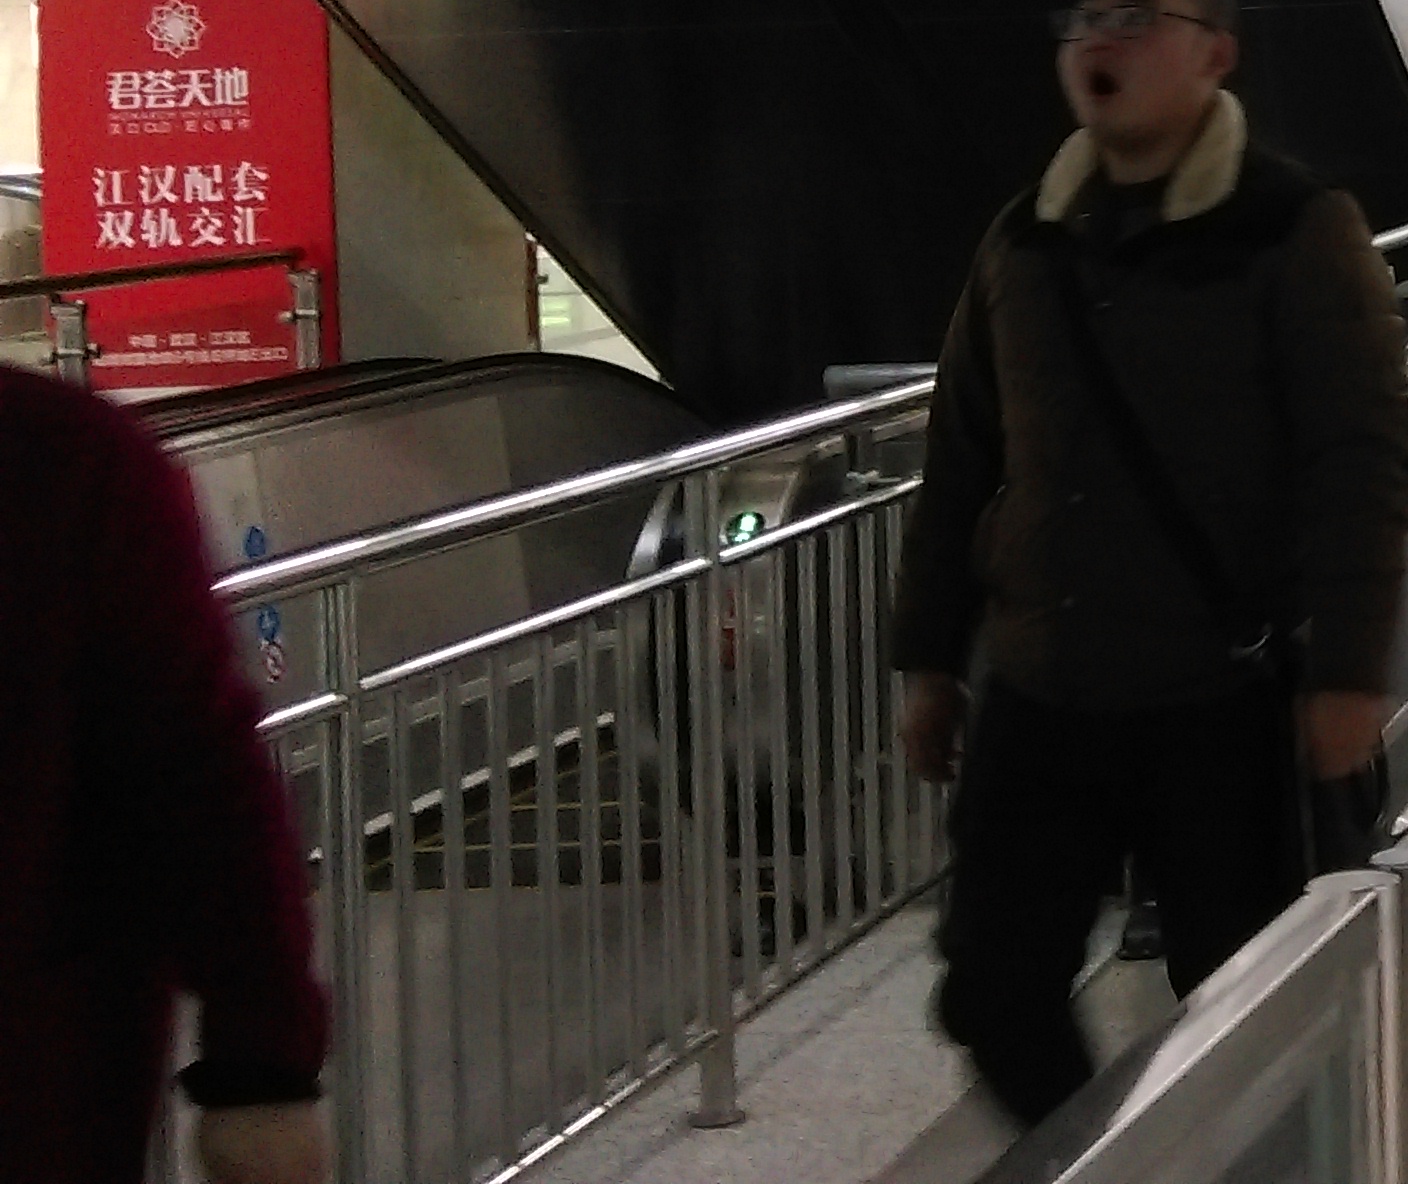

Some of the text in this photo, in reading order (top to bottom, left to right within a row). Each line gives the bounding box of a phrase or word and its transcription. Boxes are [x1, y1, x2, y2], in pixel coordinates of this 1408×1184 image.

[105, 67, 250, 110] 君荟天地
[91, 161, 270, 208] 江汉配套
[94, 205, 273, 249] 双轨交汇
